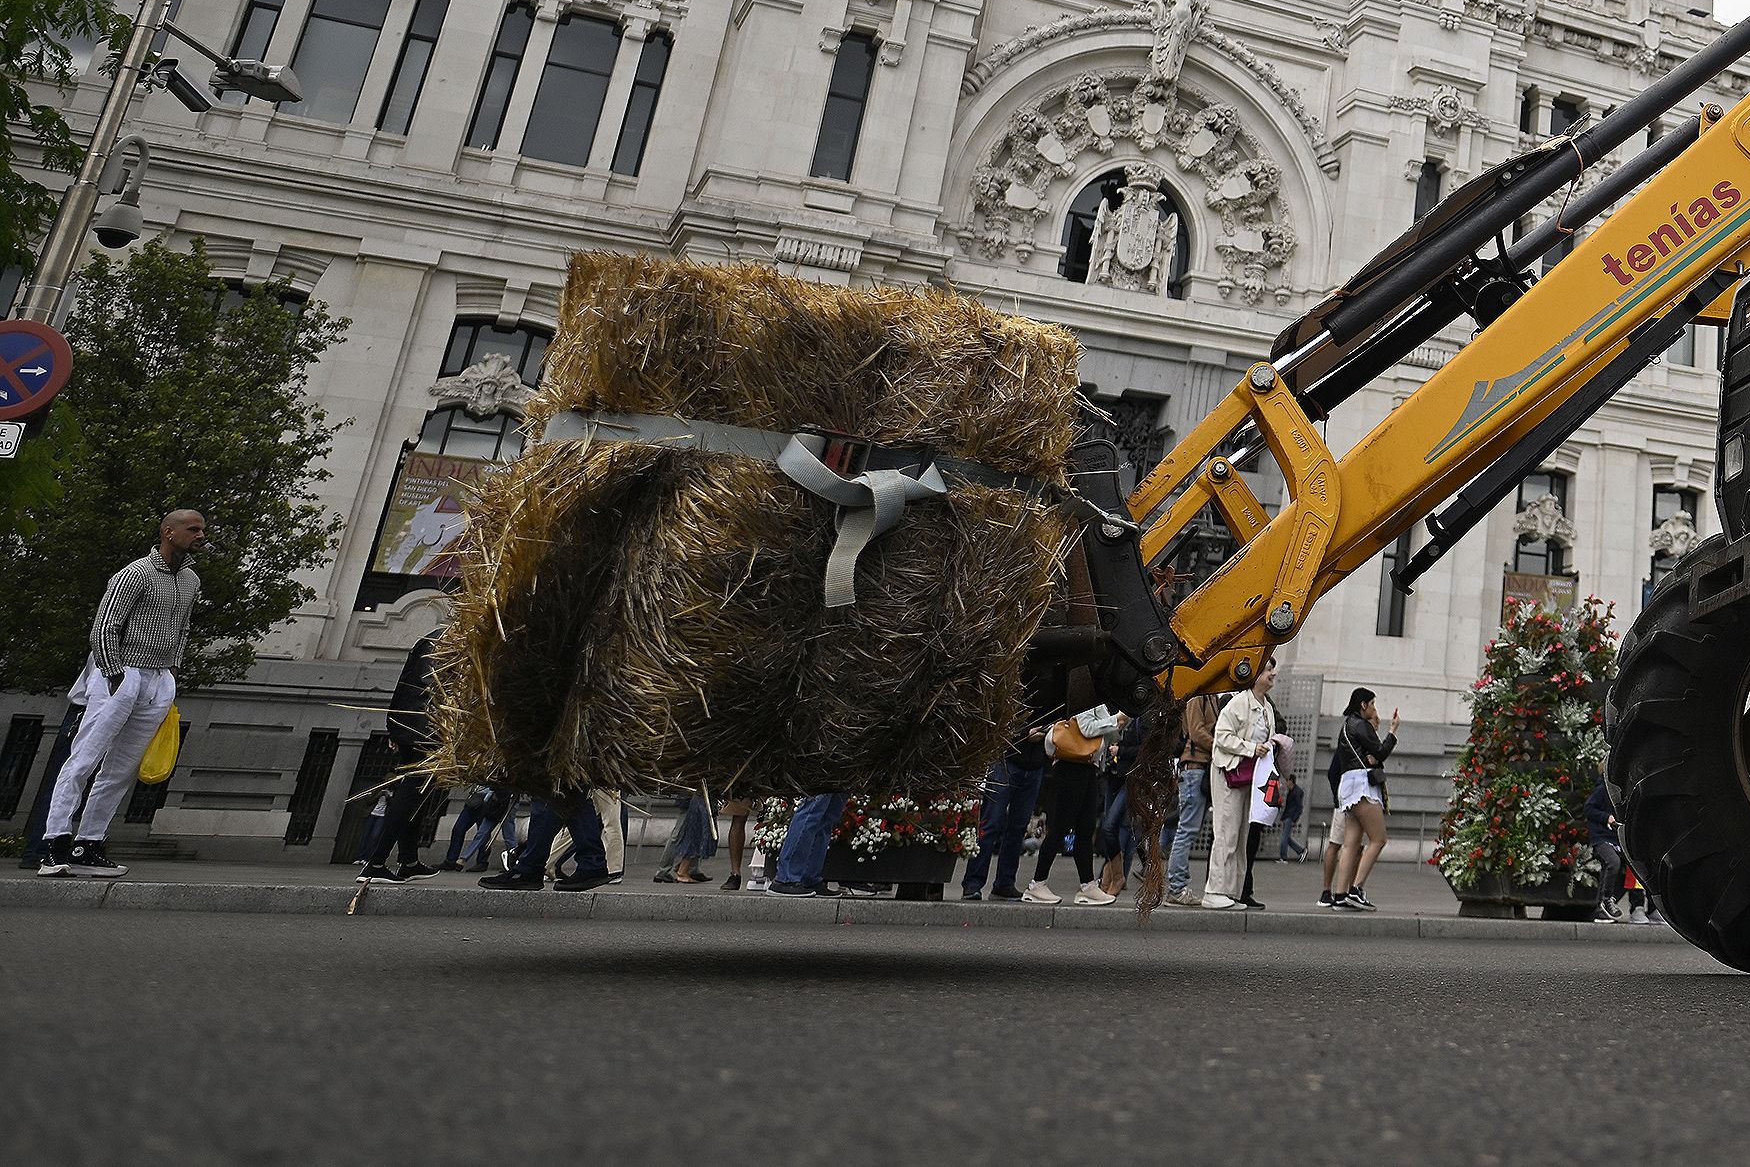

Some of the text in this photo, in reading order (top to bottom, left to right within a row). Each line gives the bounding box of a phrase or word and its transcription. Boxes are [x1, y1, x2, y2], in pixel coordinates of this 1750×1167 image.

[1601, 180, 1741, 286] tenías
[407, 456, 481, 482] INDIA
[405, 477, 437, 486] PINTURAS
[403, 484, 438, 493] SAN DIEGO
[401, 492, 430, 500] MUSEUM
